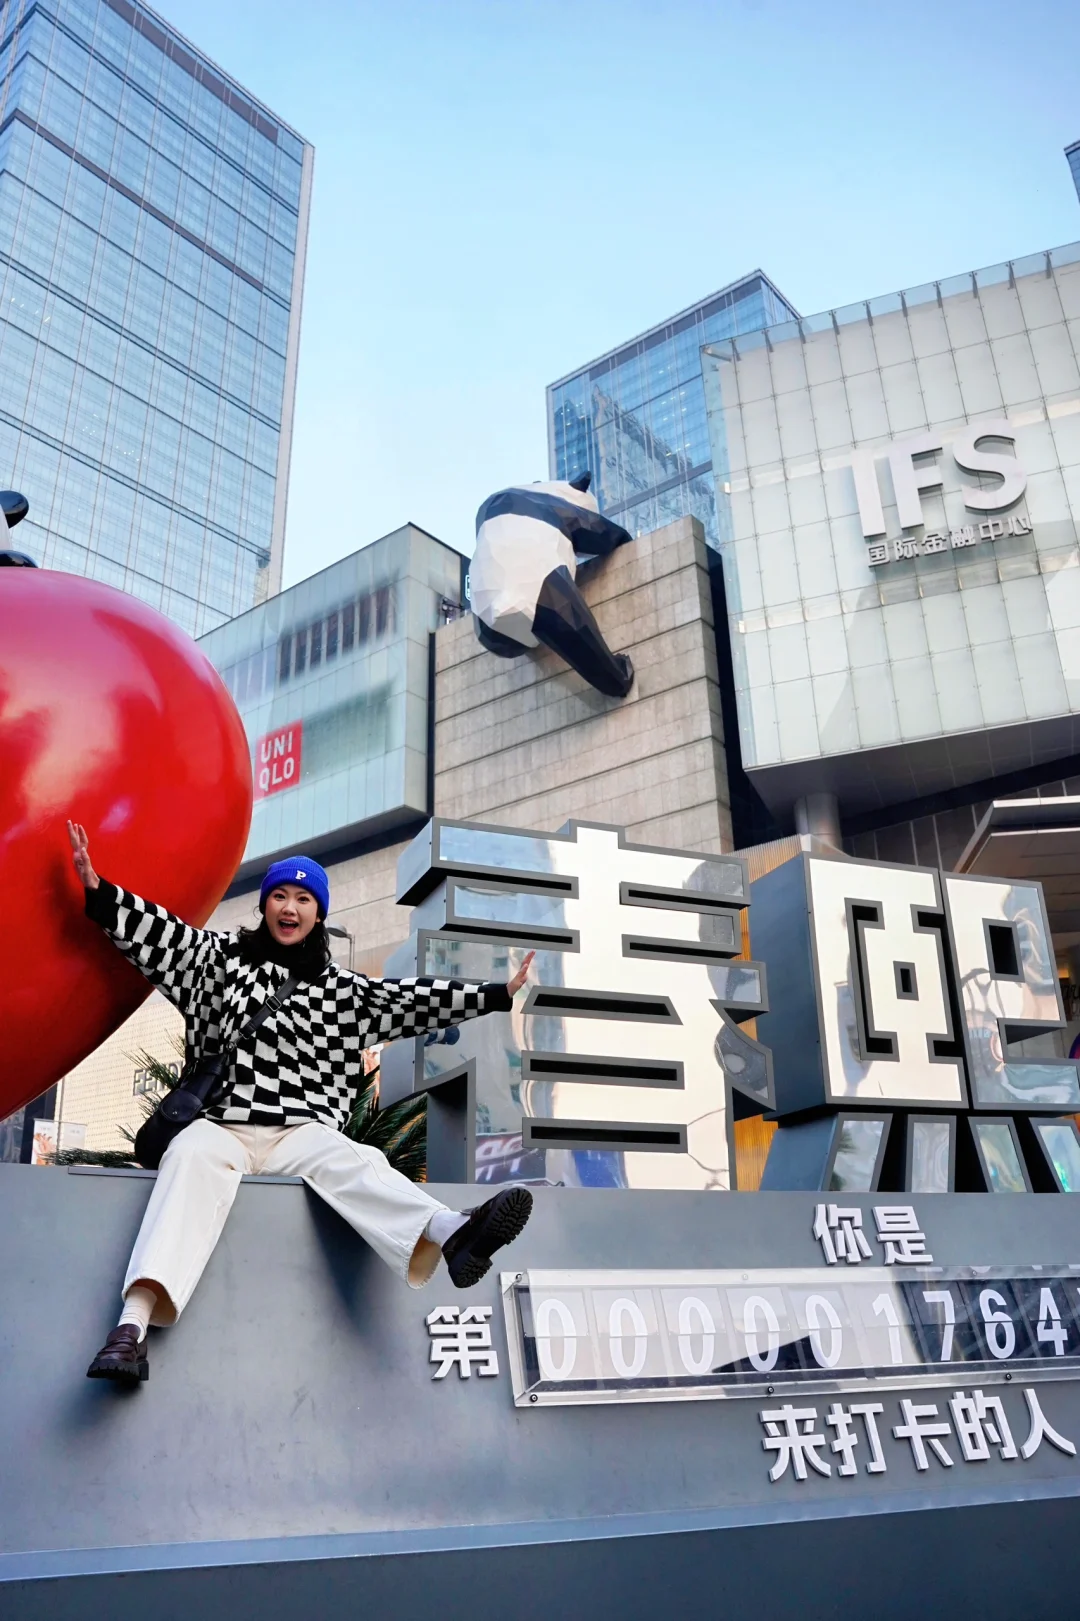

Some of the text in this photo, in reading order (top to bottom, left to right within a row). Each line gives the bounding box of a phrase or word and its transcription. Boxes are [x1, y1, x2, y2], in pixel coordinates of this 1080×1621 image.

[850, 419, 1027, 538] IFS
[868, 515, 1033, 567] 国际金融中心
[259, 757, 295, 791] QLO
[260, 731, 293, 763] UNI
[295, 870, 306, 880] P
[408, 818, 1080, 1193] 春熙
[813, 1204, 933, 1265] 你是
[427, 1286, 1080, 1382] 第 000001764
[760, 1388, 1077, 1482] 来打卡的人
